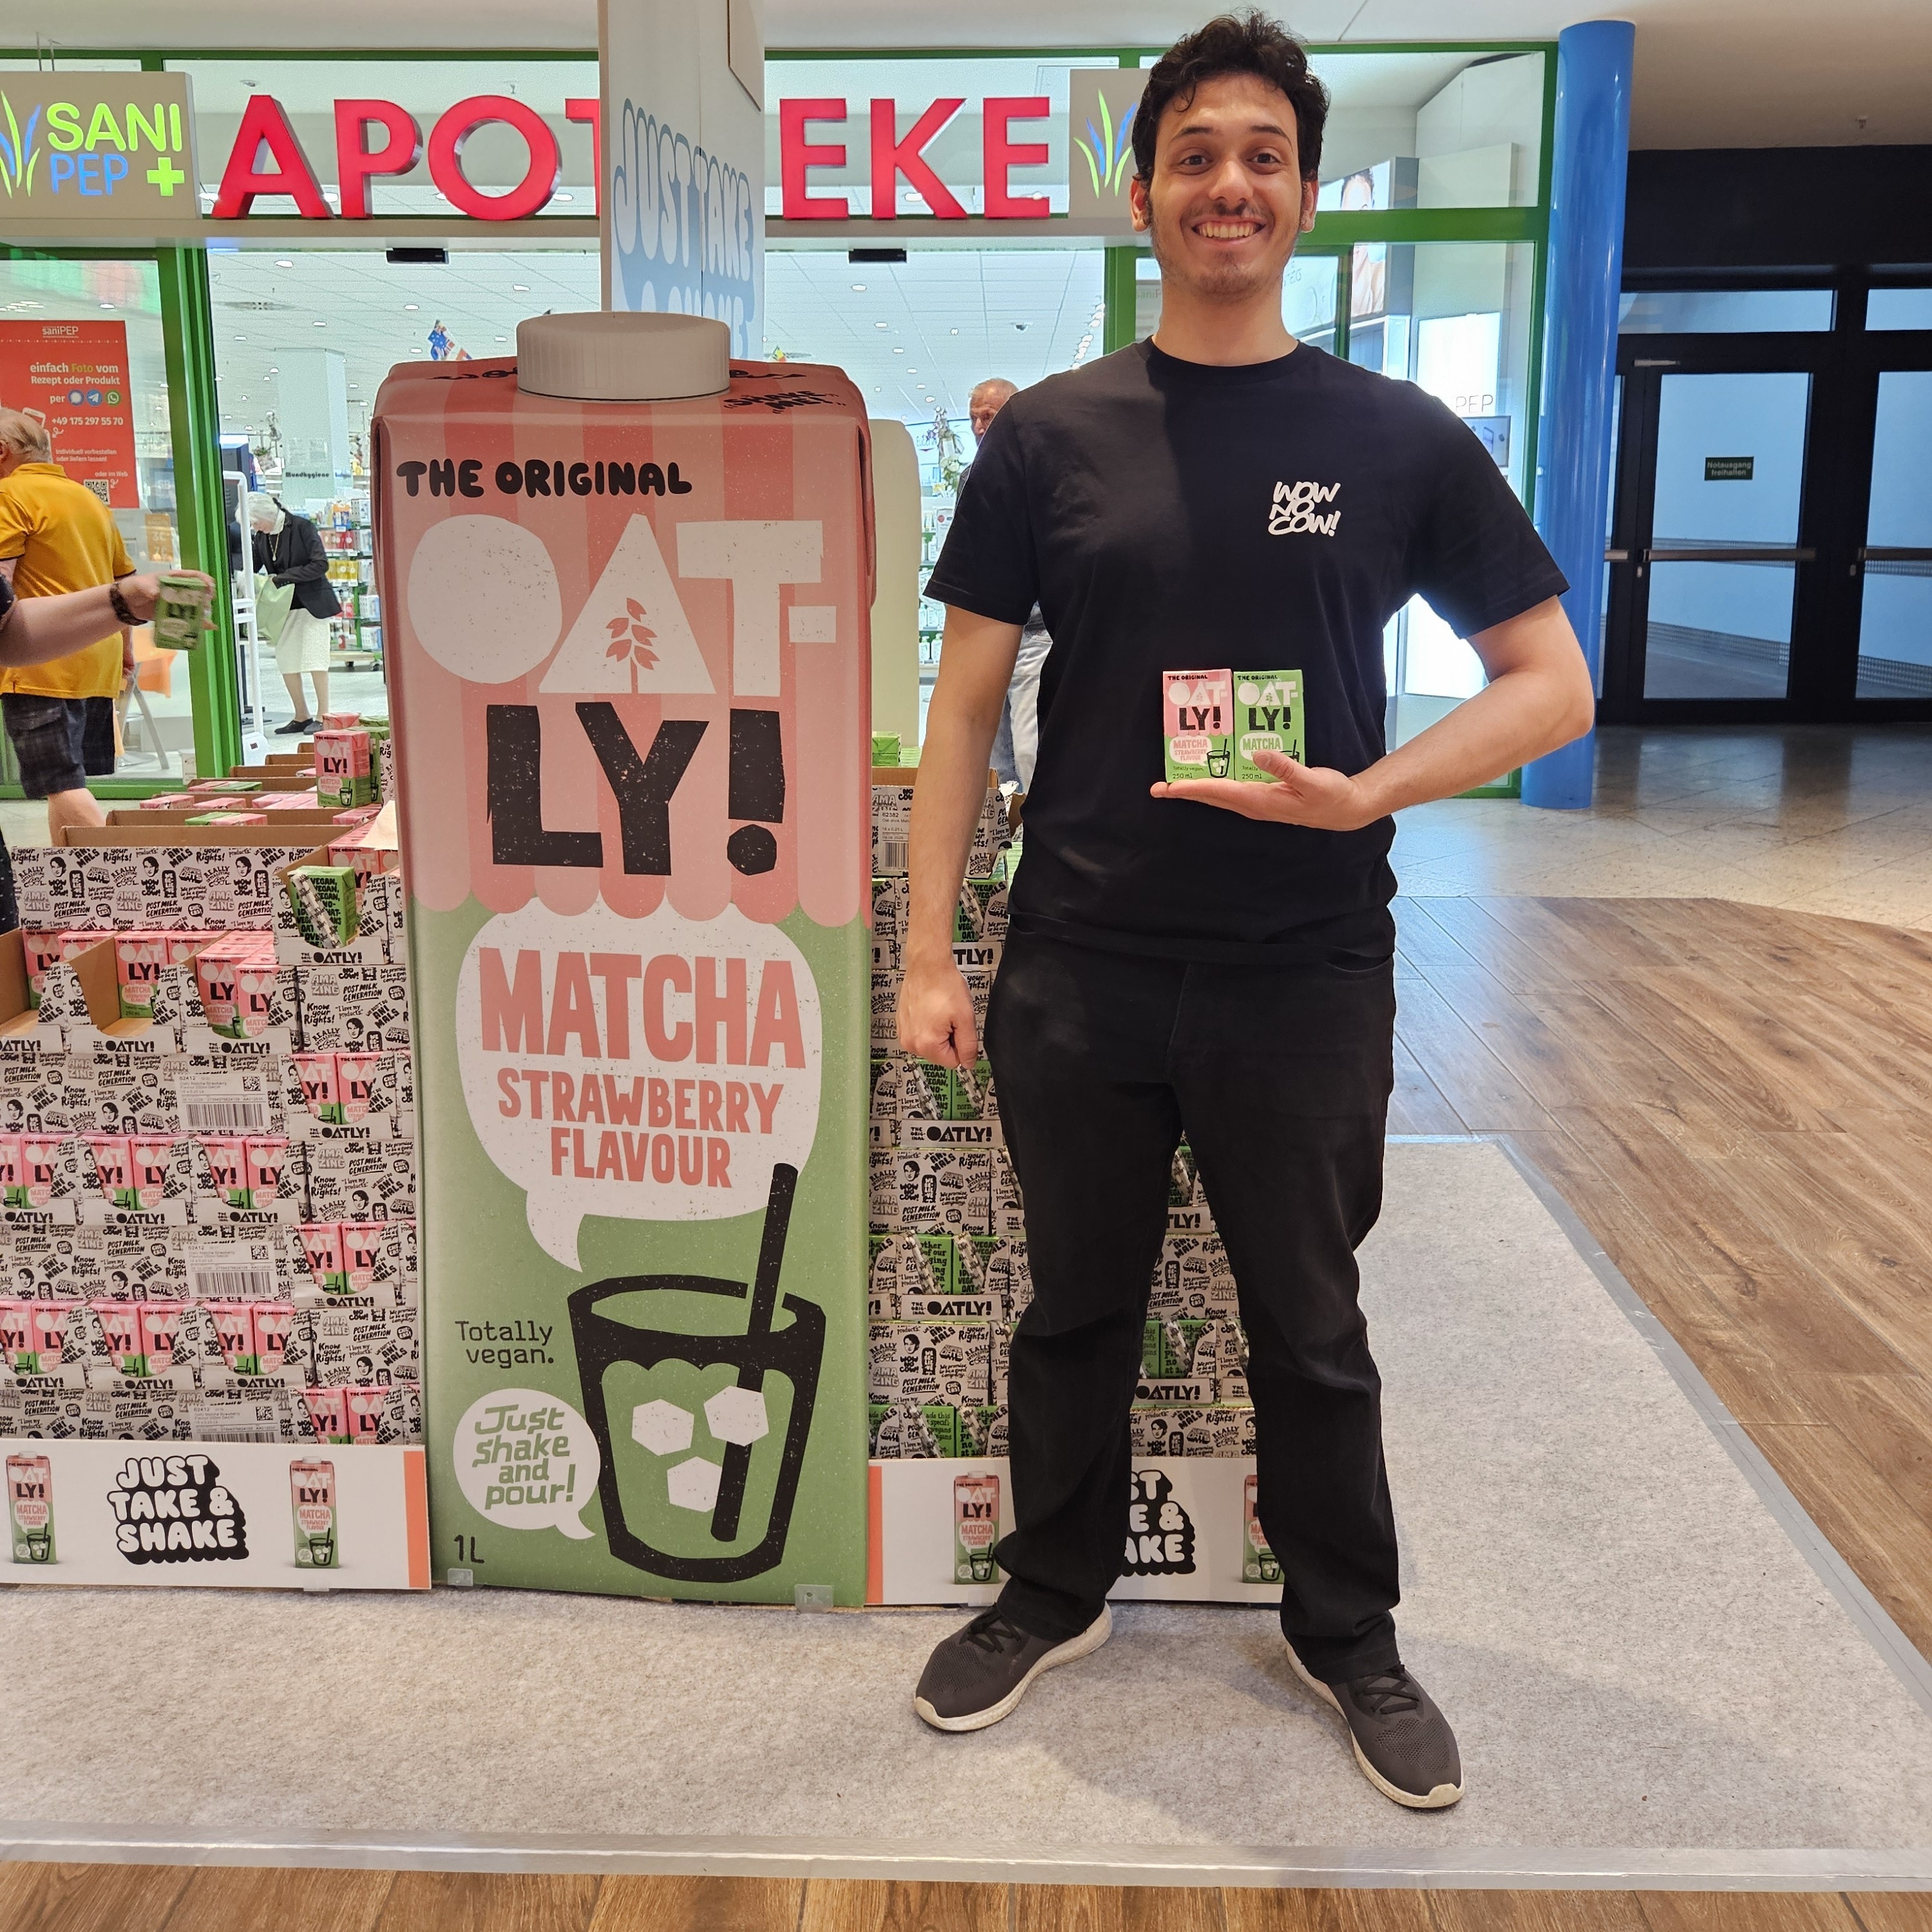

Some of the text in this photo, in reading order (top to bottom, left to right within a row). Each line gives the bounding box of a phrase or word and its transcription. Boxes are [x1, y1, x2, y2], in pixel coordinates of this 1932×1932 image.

[46, 102, 182, 153] SANI
[50, 154, 129, 196] PEP
[614, 103, 752, 282] JUST TAKE
[42, 326, 79, 336] saniPEP
[30, 362, 118, 374] einfach Foto vom
[31, 376, 120, 386] Rezept oder Produkt
[50, 395, 65, 404] per
[1456, 394, 1493, 413] PEP
[52, 417, 123, 426] +49 175 297 55 70
[397, 459, 693, 498] THE ORIGINAL
[1273, 482, 1341, 503] WOW
[1269, 498, 1315, 520] NO
[1268, 511, 1341, 536] COW!
[1179, 706, 1221, 730] LY!
[1248, 706, 1291, 731] LY!
[1173, 739, 1208, 748] MATCHA
[1242, 738, 1280, 750] MATCHA
[324, 757, 347, 773] LY!
[486, 702, 786, 876] LY!
[54, 902, 68, 910] POST
[55, 907, 90, 917] GENERATION
[146, 902, 160, 910] POST
[146, 907, 182, 917] GENERATION
[313, 952, 363, 964] OATLY!
[953, 949, 994, 965] TLY!
[128, 963, 160, 980] LY!
[343, 985, 358, 993] POST
[343, 989, 382, 1001] GENERATION
[479, 947, 806, 1069] MATCHA
[304, 1014, 335, 1026] Rights!
[0, 1040, 41, 1052] ATLY!
[106, 1040, 155, 1052] OATLY!
[221, 1043, 270, 1054] OATLY!
[64, 1086, 86, 1094] Know
[62, 1096, 90, 1108] Rights!
[497, 1068, 784, 1134] STRAWBERRY
[322, 1127, 370, 1139] OATLY!
[927, 1126, 992, 1142] OATLY!
[349, 1159, 365, 1168] POST
[551, 1127, 732, 1188] FLAVOUR
[349, 1163, 387, 1175] GENERATION
[314, 1175, 336, 1184] Know
[311, 1187, 341, 1198] Rights!
[229, 1212, 278, 1222] OATLY!
[902, 1206, 918, 1216] POST
[902, 1212, 940, 1222] GENERATION
[5, 1212, 53, 1224] OATLY!
[116, 1213, 165, 1224] OATLY!
[1166, 1213, 1200, 1228] TLY!
[326, 1297, 374, 1307] OATLY!
[927, 1301, 991, 1316] OATLY!
[455, 1321, 553, 1346] Totally
[466, 1347, 554, 1369] vegan.
[15, 1377, 64, 1388] OATLY!
[125, 1379, 173, 1389] OATLY!
[237, 1378, 285, 1388] OATLY!
[1135, 1385, 1200, 1400] OATLY!
[475, 1405, 565, 1435] Just
[472, 1433, 571, 1468] shake
[117, 1455, 210, 1488] JUST
[498, 1458, 549, 1483] and
[16, 1483, 44, 1498] LY!
[485, 1464, 576, 1510] pour!
[300, 1488, 328, 1502] LY!
[17, 1504, 47, 1514] MATCHA
[109, 1486, 234, 1520] TAKE &
[299, 1510, 330, 1519] MATCHA
[963, 1503, 991, 1518] LY!
[1159, 1502, 1184, 1531] &
[117, 1519, 238, 1553] SHAKE
[961, 1525, 992, 1535] MATCHA
[454, 1535, 485, 1564] 1L
[1124, 1534, 1185, 1564] AKE
